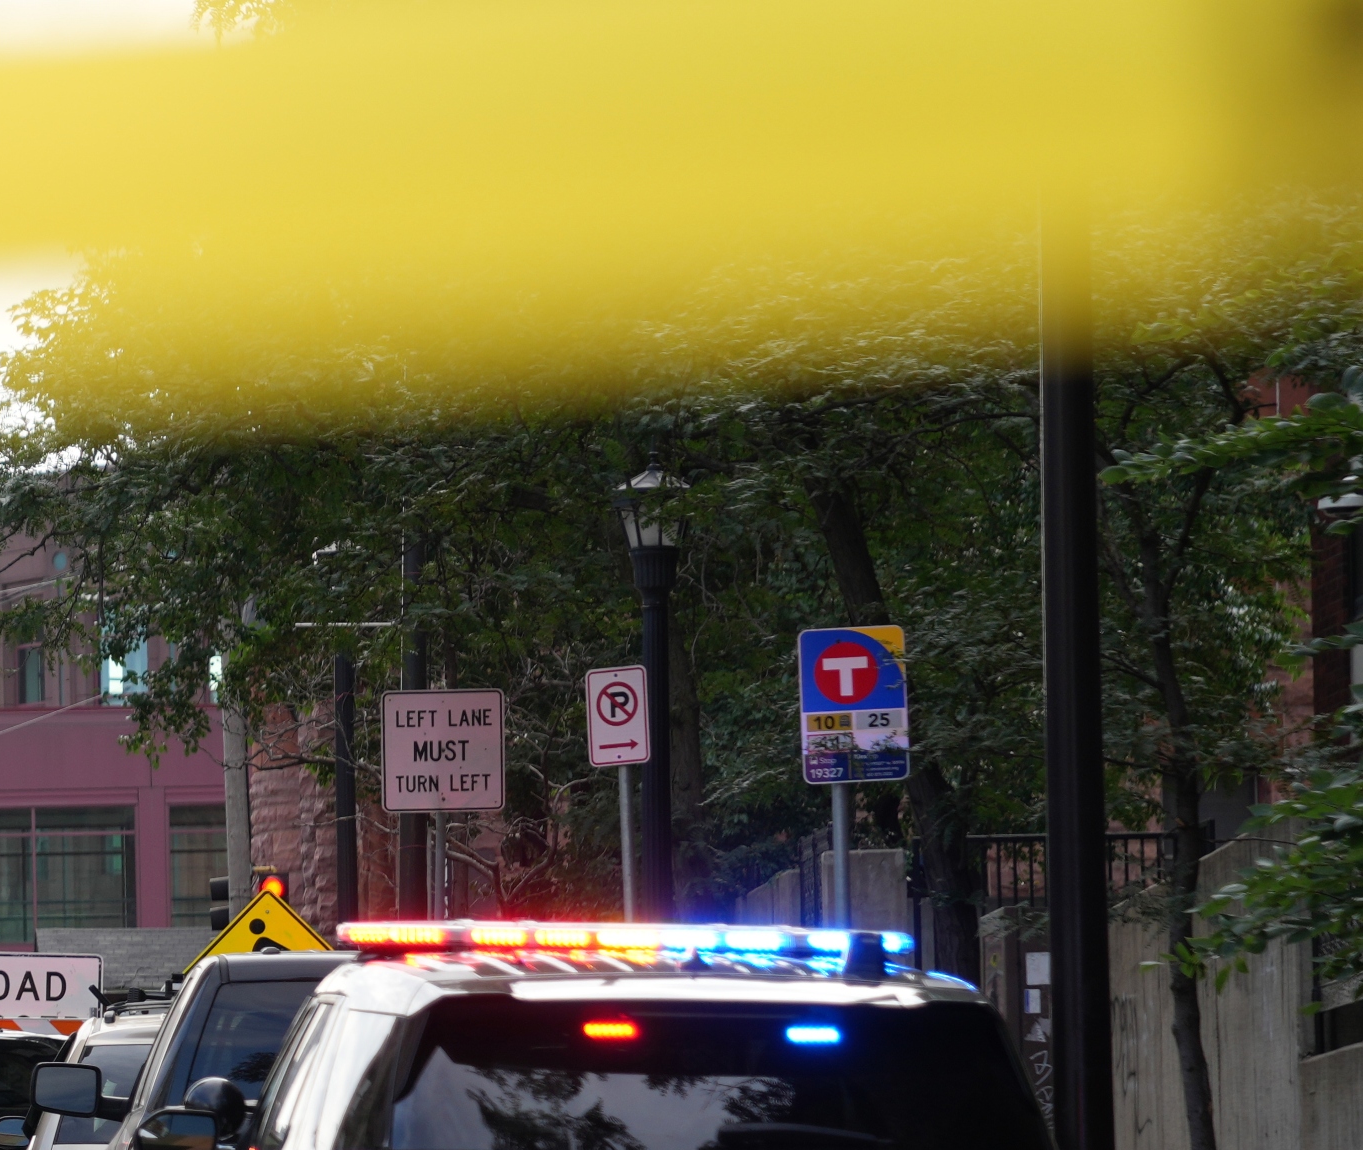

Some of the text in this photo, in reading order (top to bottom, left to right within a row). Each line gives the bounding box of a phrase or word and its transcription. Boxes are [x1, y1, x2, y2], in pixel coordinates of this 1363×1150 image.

[822, 656, 868, 696] T
[396, 709, 492, 728] LEFT LANE
[814, 713, 890, 729] 10 25
[413, 740, 469, 762] MUST
[810, 767, 843, 779] 19327
[396, 774, 491, 793] TURN LEFT
